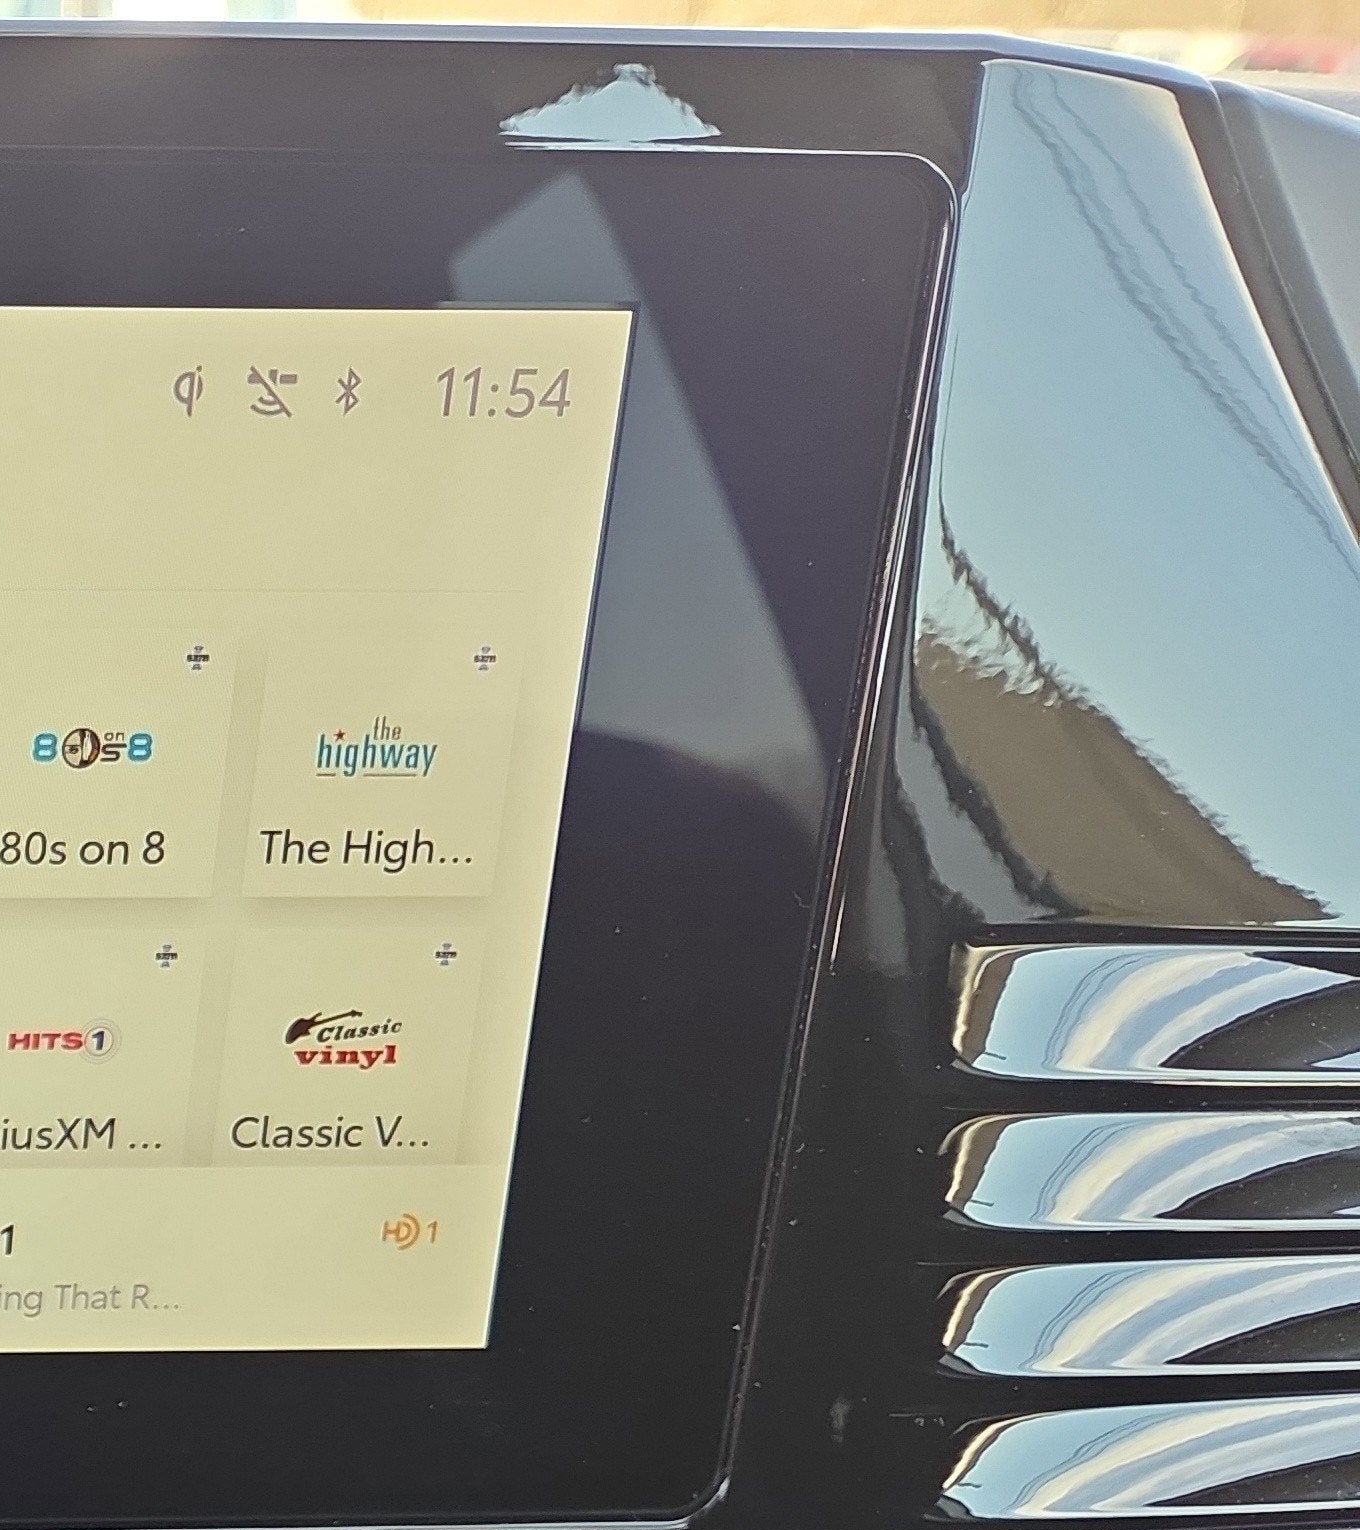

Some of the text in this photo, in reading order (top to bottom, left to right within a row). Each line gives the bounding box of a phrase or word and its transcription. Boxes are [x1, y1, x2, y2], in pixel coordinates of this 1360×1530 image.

[437, 367, 570, 418] 11:54
[374, 716, 401, 740] the
[128, 733, 153, 761] 8
[316, 732, 437, 777] highway
[0, 831, 164, 864] 80s on 8
[260, 829, 330, 864] The
[8, 1031, 104, 1050] HITS 1
[316, 1018, 403, 1042] Classic
[294, 1045, 396, 1069] vinyl
[232, 1116, 363, 1148] Classic
[54, 1283, 121, 1309] That
